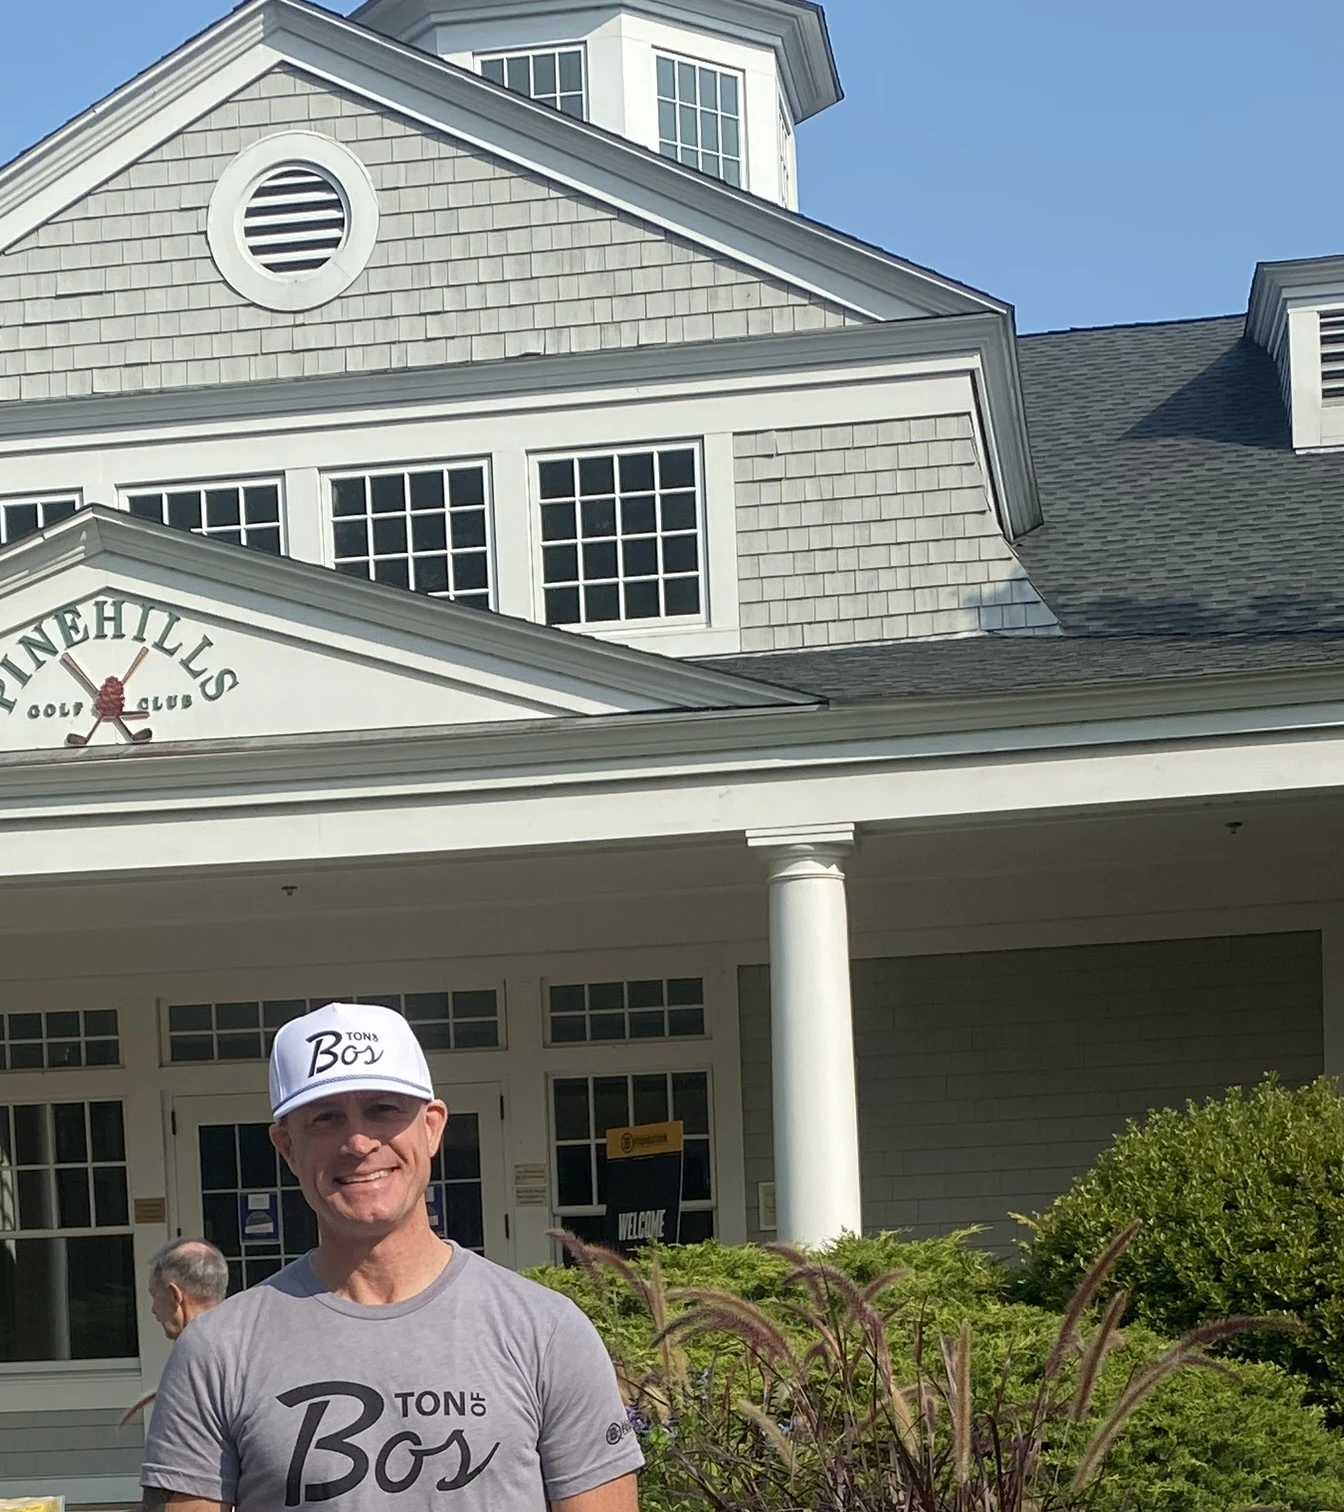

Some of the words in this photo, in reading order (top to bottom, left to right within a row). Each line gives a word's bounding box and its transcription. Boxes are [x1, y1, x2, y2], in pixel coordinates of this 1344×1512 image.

[27, 701, 83, 719] GOLF
[137, 694, 193, 711] CLUB
[345, 1031, 371, 1041] TON
[305, 1030, 384, 1078] Bos
[618, 1209, 667, 1241] WELCOME
[394, 1390, 468, 1418] TON
[470, 1391, 487, 1417] OF
[275, 1380, 500, 1506] Bos
